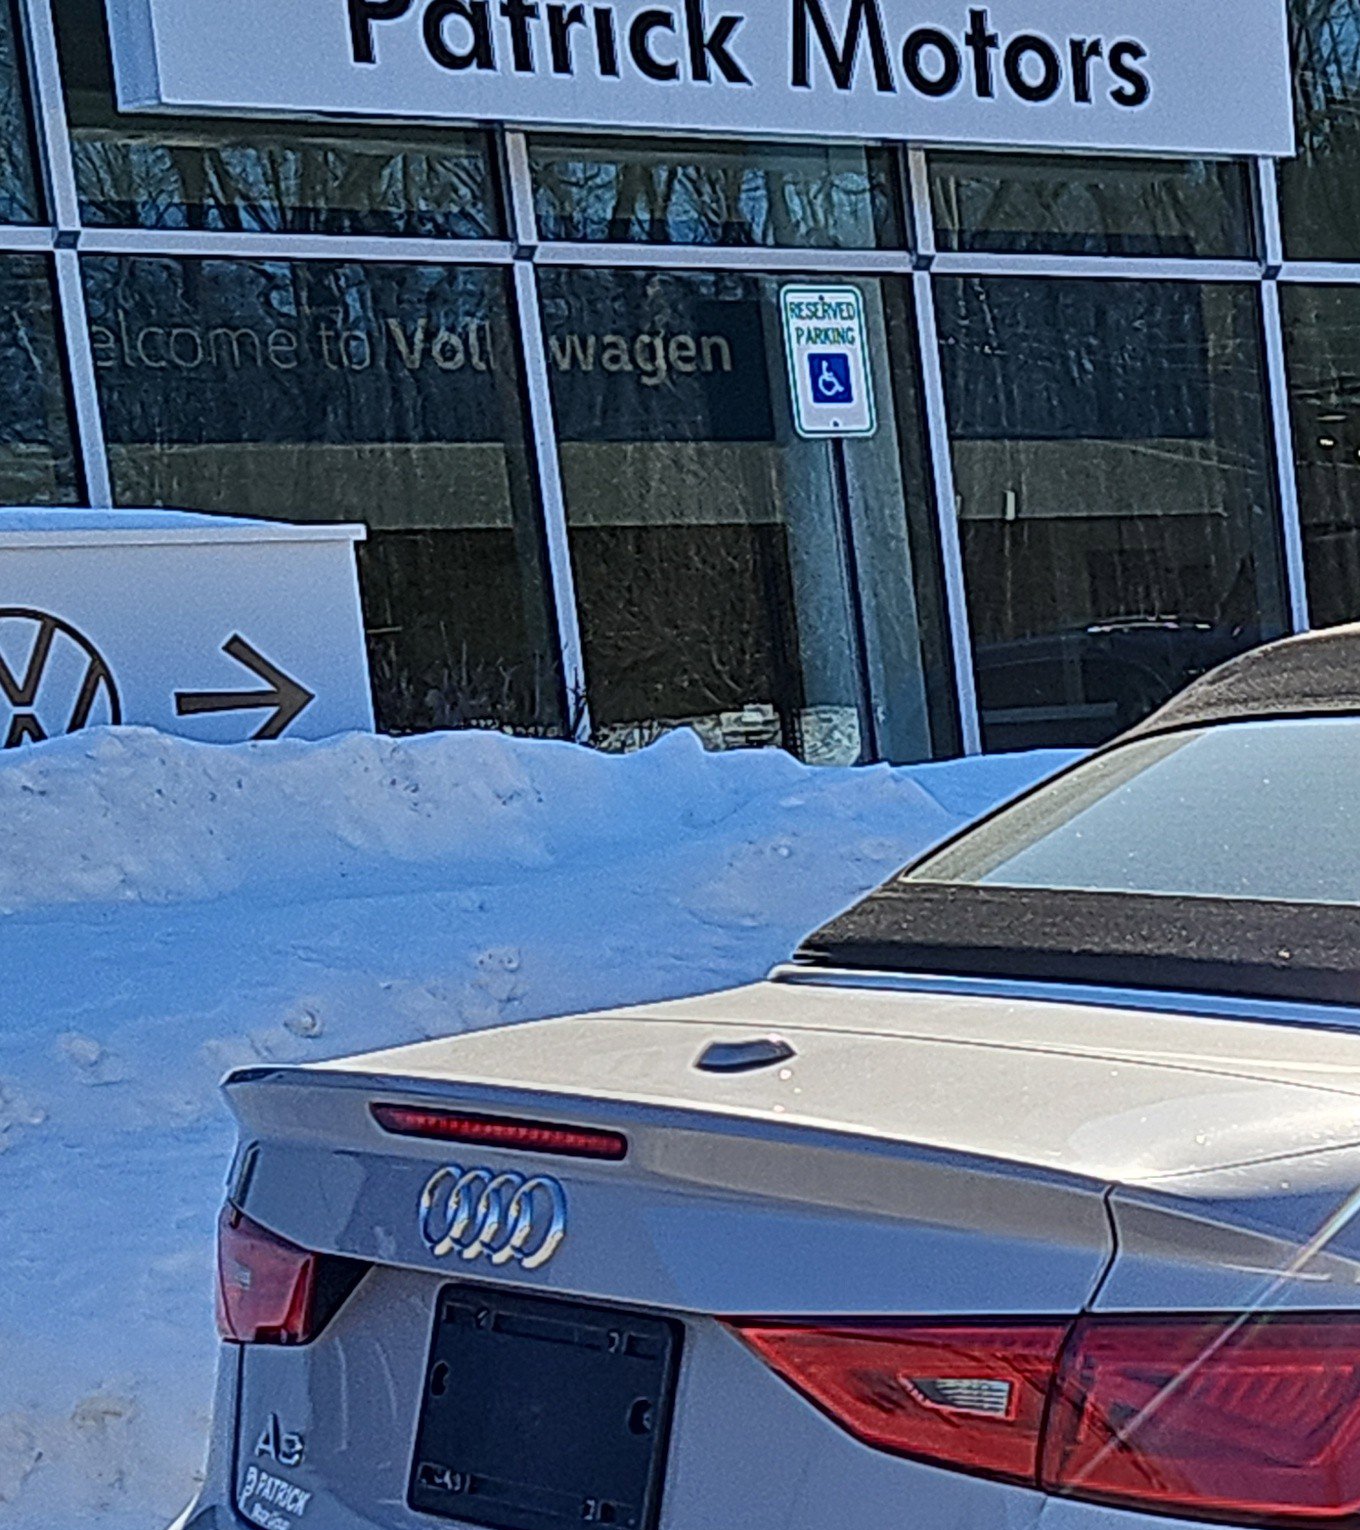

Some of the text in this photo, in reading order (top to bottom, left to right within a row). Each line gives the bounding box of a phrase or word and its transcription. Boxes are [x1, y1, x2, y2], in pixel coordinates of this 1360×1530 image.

[346, 0, 1152, 108] Patrick Motors
[788, 301, 856, 321] RESERVED
[91, 307, 733, 387] elcome to Volwagen
[795, 326, 856, 346] PARKING
[256, 1471, 312, 1517] PATRICK
